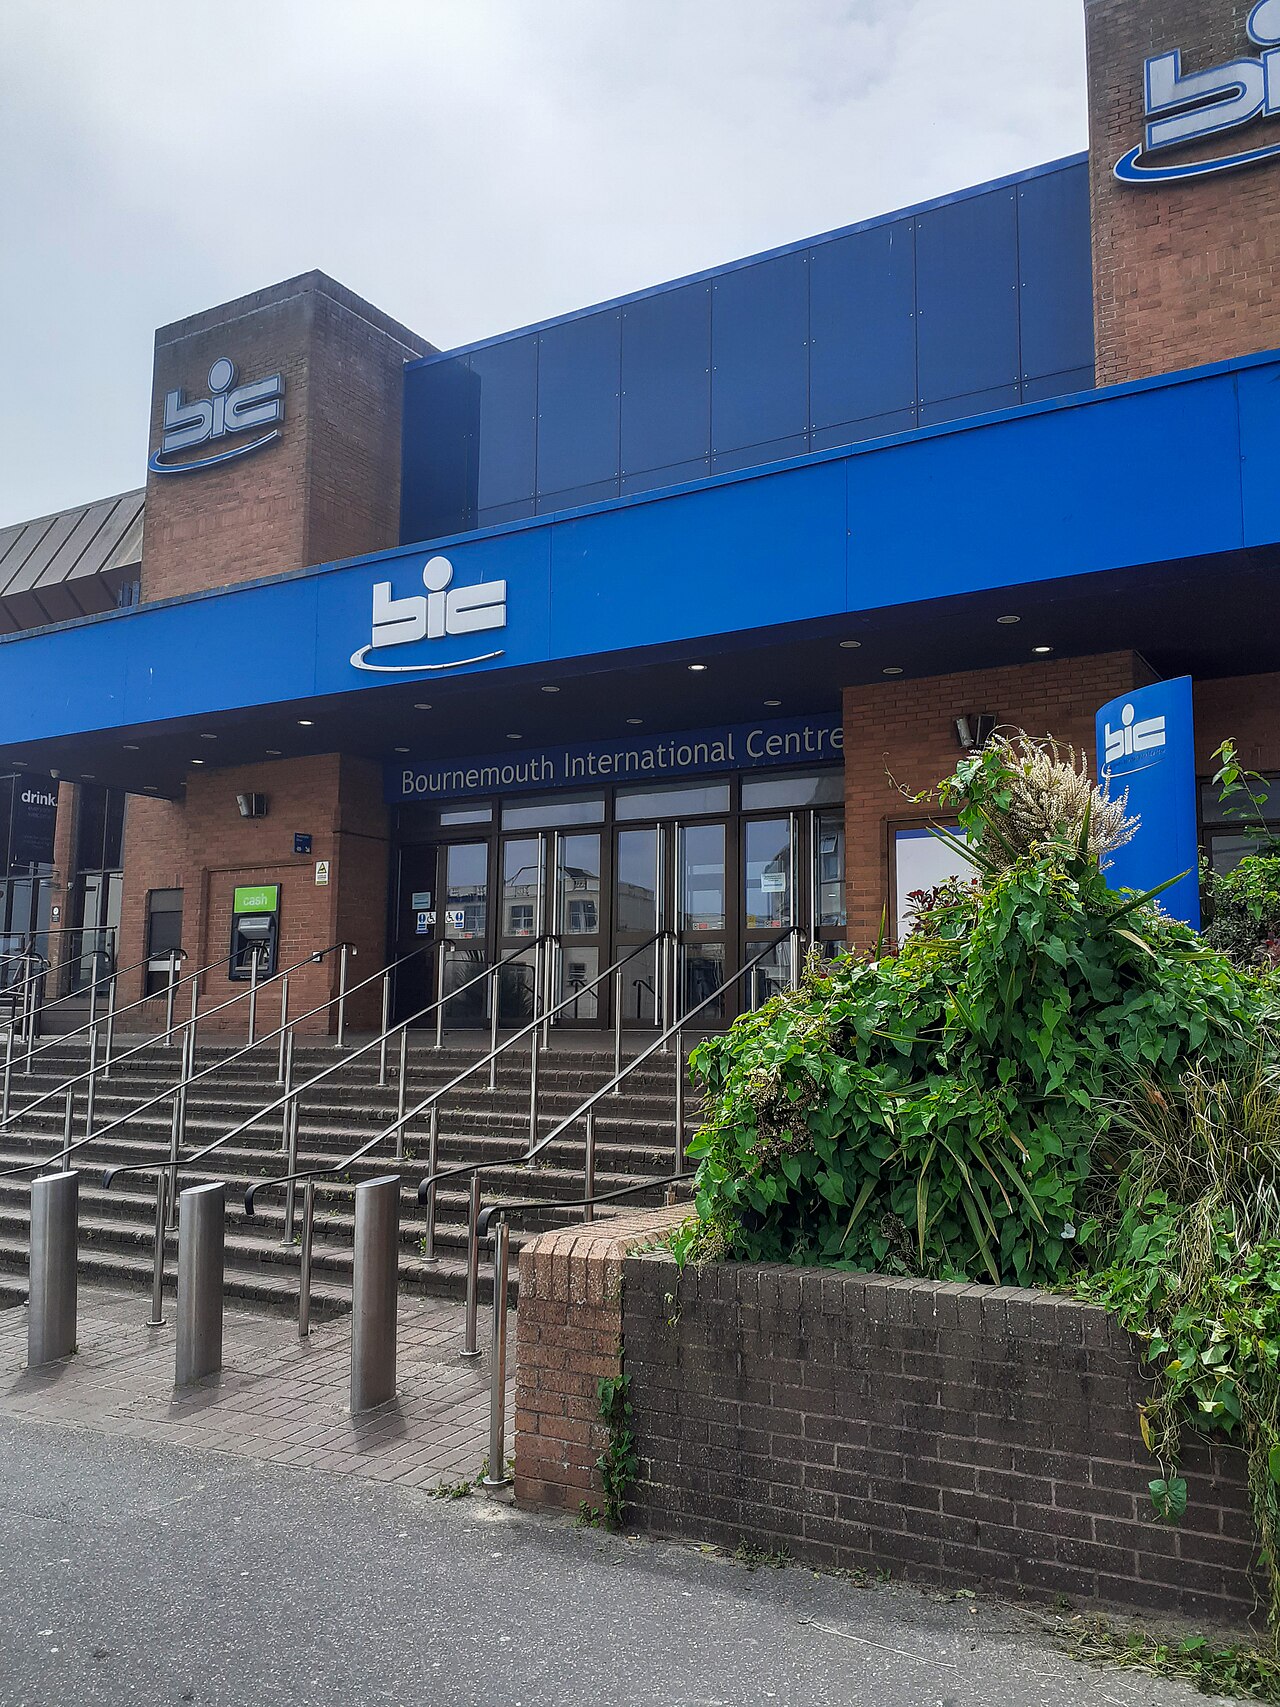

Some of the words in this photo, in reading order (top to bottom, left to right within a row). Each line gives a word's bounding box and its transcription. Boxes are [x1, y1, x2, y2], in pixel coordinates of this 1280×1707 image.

[163, 357, 285, 453] bic
[372, 556, 507, 648] bic
[402, 754, 554, 794] Bournemouth
[564, 733, 735, 778] International
[746, 726, 844, 758] Centre
[1105, 704, 1166, 764] bic
[21, 789, 58, 807] drink.
[243, 893, 268, 906] cash
